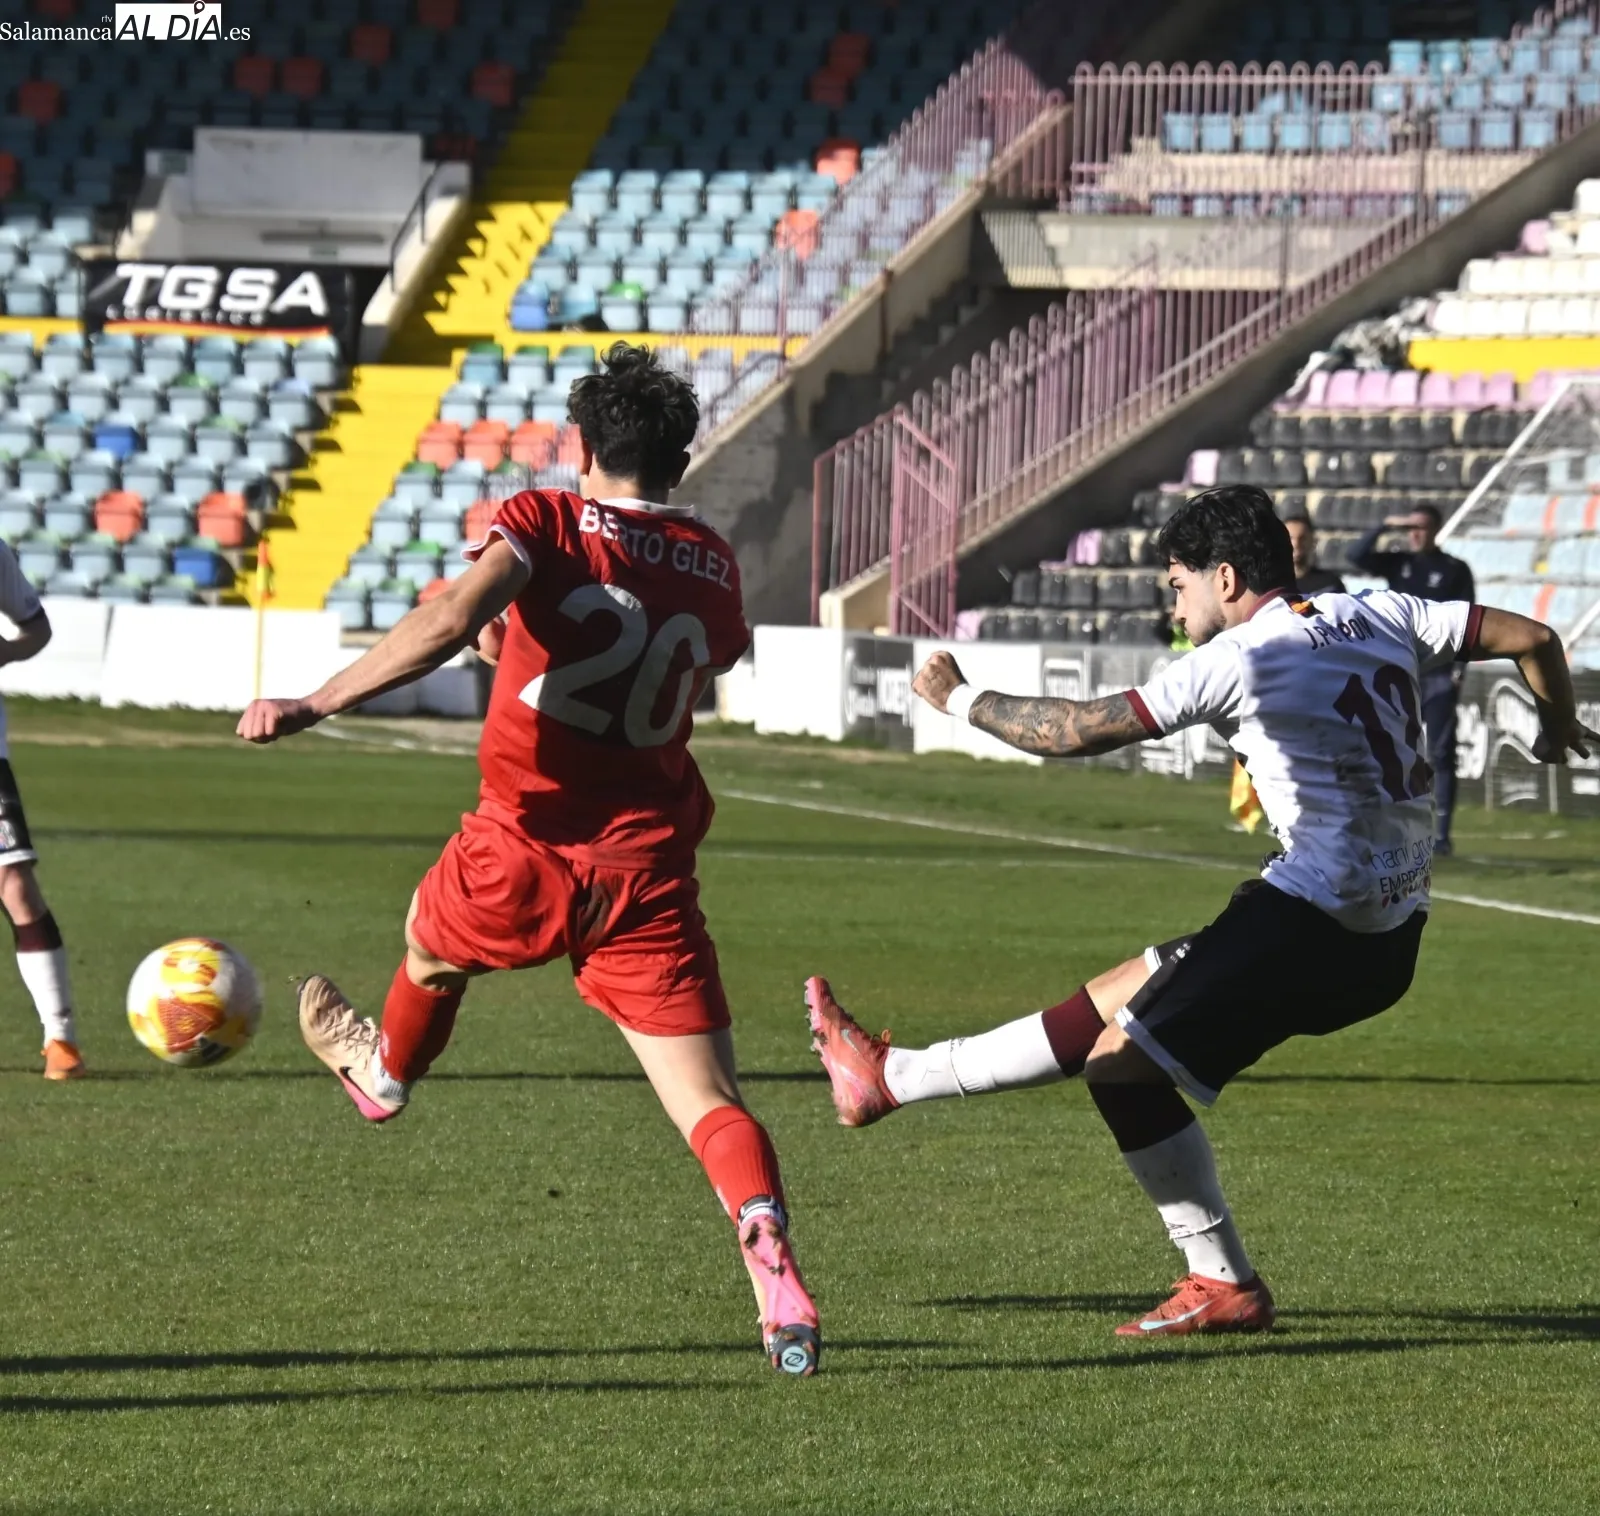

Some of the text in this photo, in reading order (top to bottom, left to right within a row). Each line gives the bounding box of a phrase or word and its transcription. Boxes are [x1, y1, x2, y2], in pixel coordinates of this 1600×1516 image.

[116, 263, 328, 316] TGSA
[578, 503, 665, 565] BERTO
[518, 583, 710, 748] 20
[1333, 664, 1434, 800] 12
